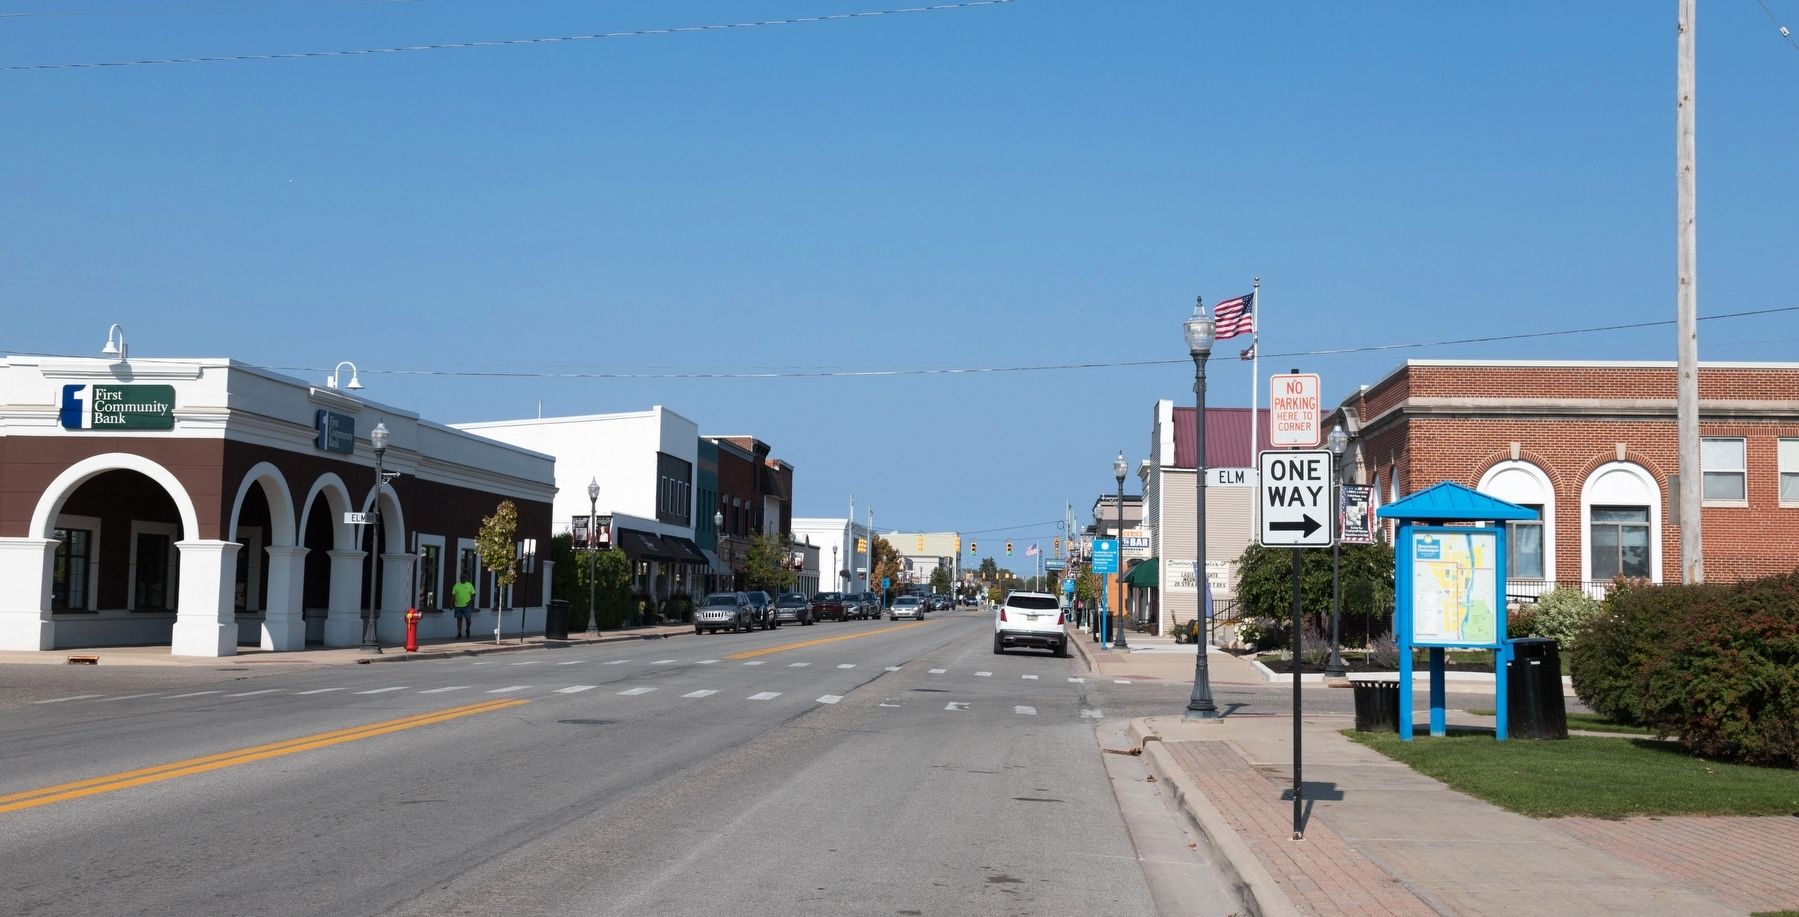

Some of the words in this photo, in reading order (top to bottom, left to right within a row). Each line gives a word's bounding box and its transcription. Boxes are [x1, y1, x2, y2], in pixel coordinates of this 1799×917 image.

[1286, 381, 1303, 394] NO
[95, 388, 123, 400] First
[94, 400, 169, 416] Community
[1274, 397, 1316, 410] PARKING
[94, 412, 127, 424] Bank
[1277, 412, 1298, 420] HERE
[1303, 411, 1313, 420] TO
[1278, 422, 1312, 431] CORNER
[1270, 459, 1321, 481] ONE
[1219, 470, 1245, 484] ELM
[1267, 485, 1324, 507] WAY
[351, 513, 368, 523] ELM
[1129, 537, 1149, 547] BAR
